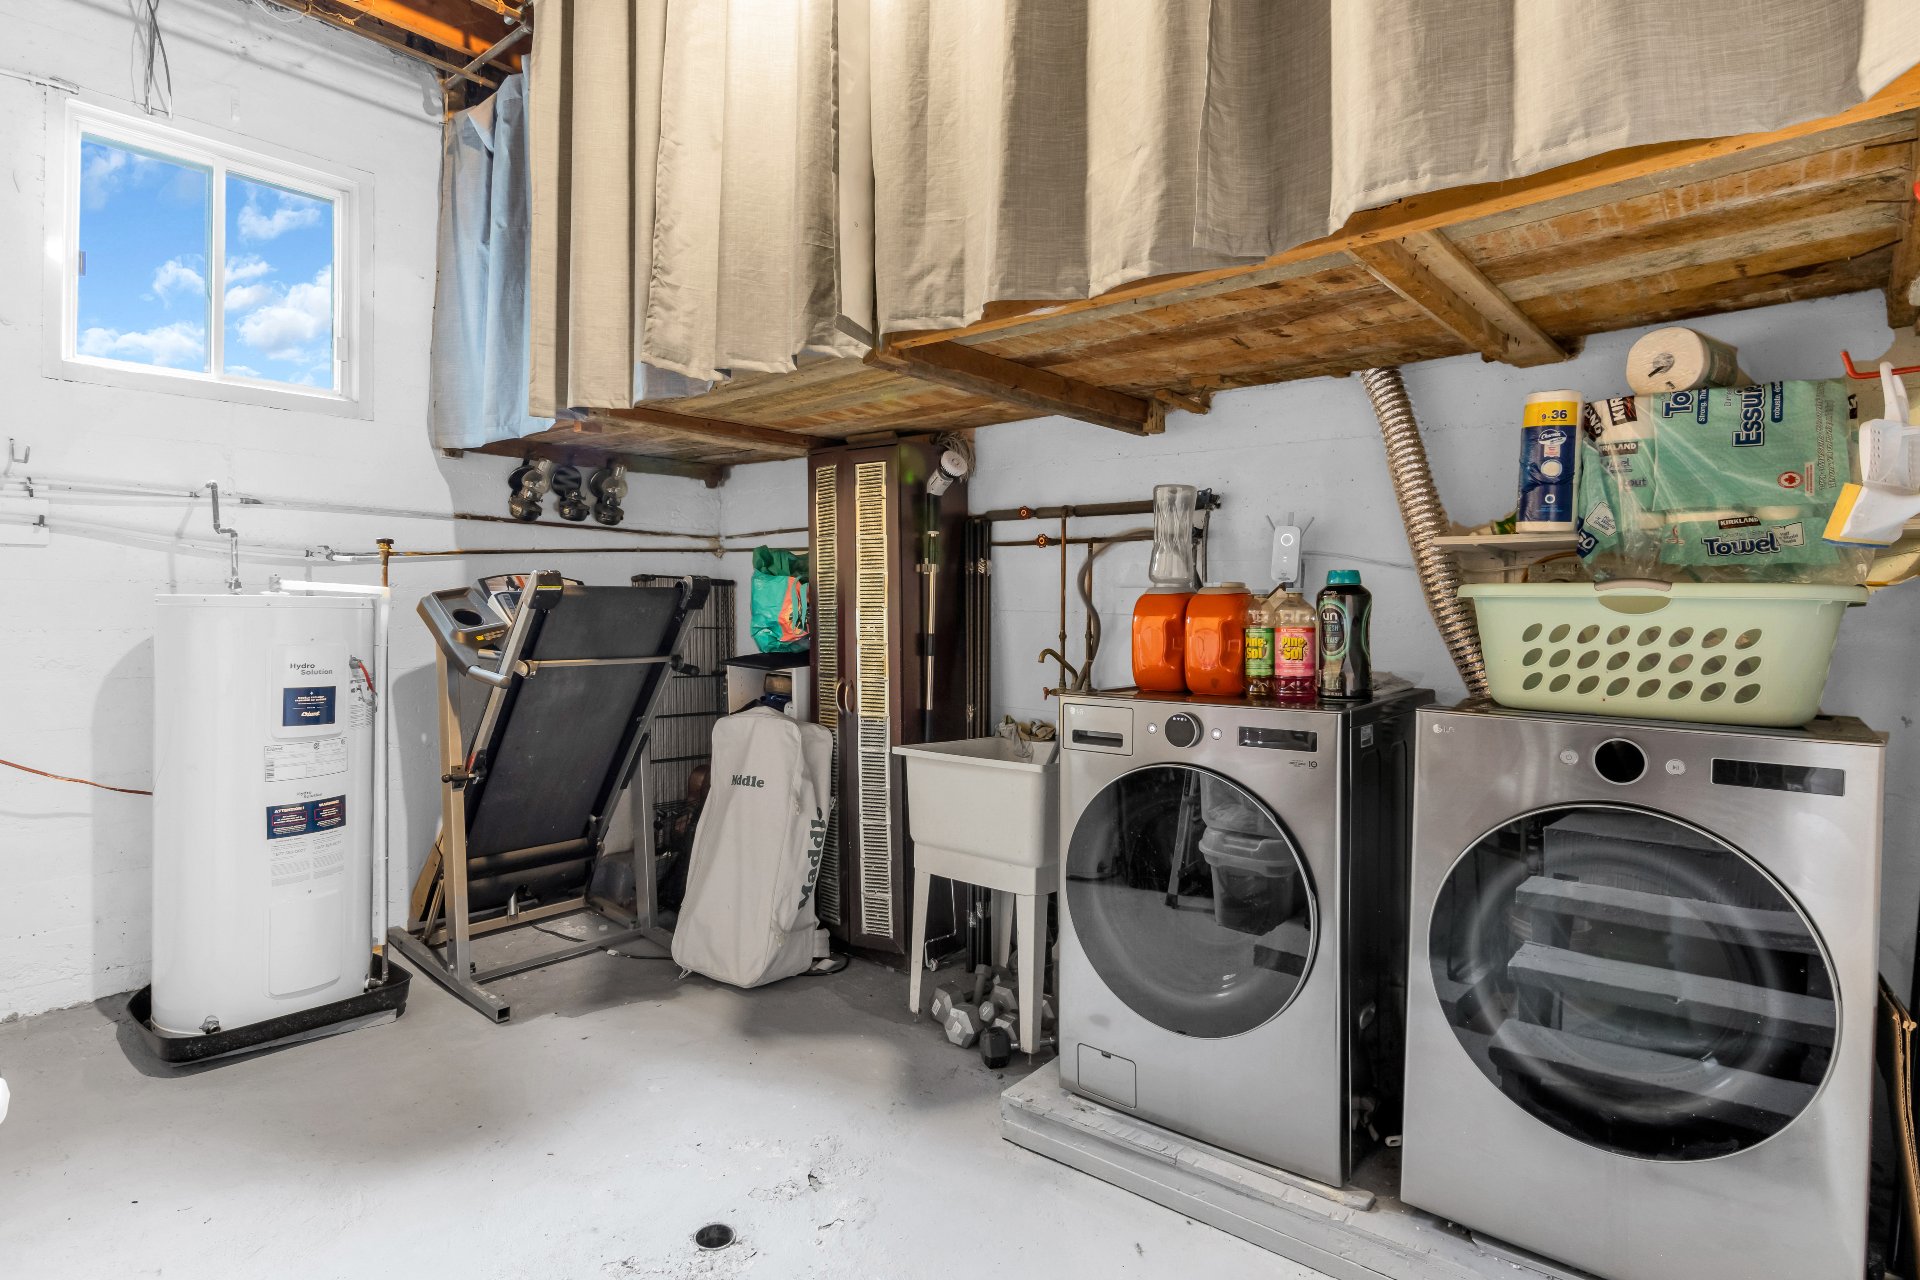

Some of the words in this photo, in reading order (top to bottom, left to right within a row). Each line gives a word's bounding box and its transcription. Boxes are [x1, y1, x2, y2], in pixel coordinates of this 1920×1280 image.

[1551, 409, 1568, 420] 36
[1701, 531, 1781, 556] Towel
[290, 663, 316, 671] Hydro
